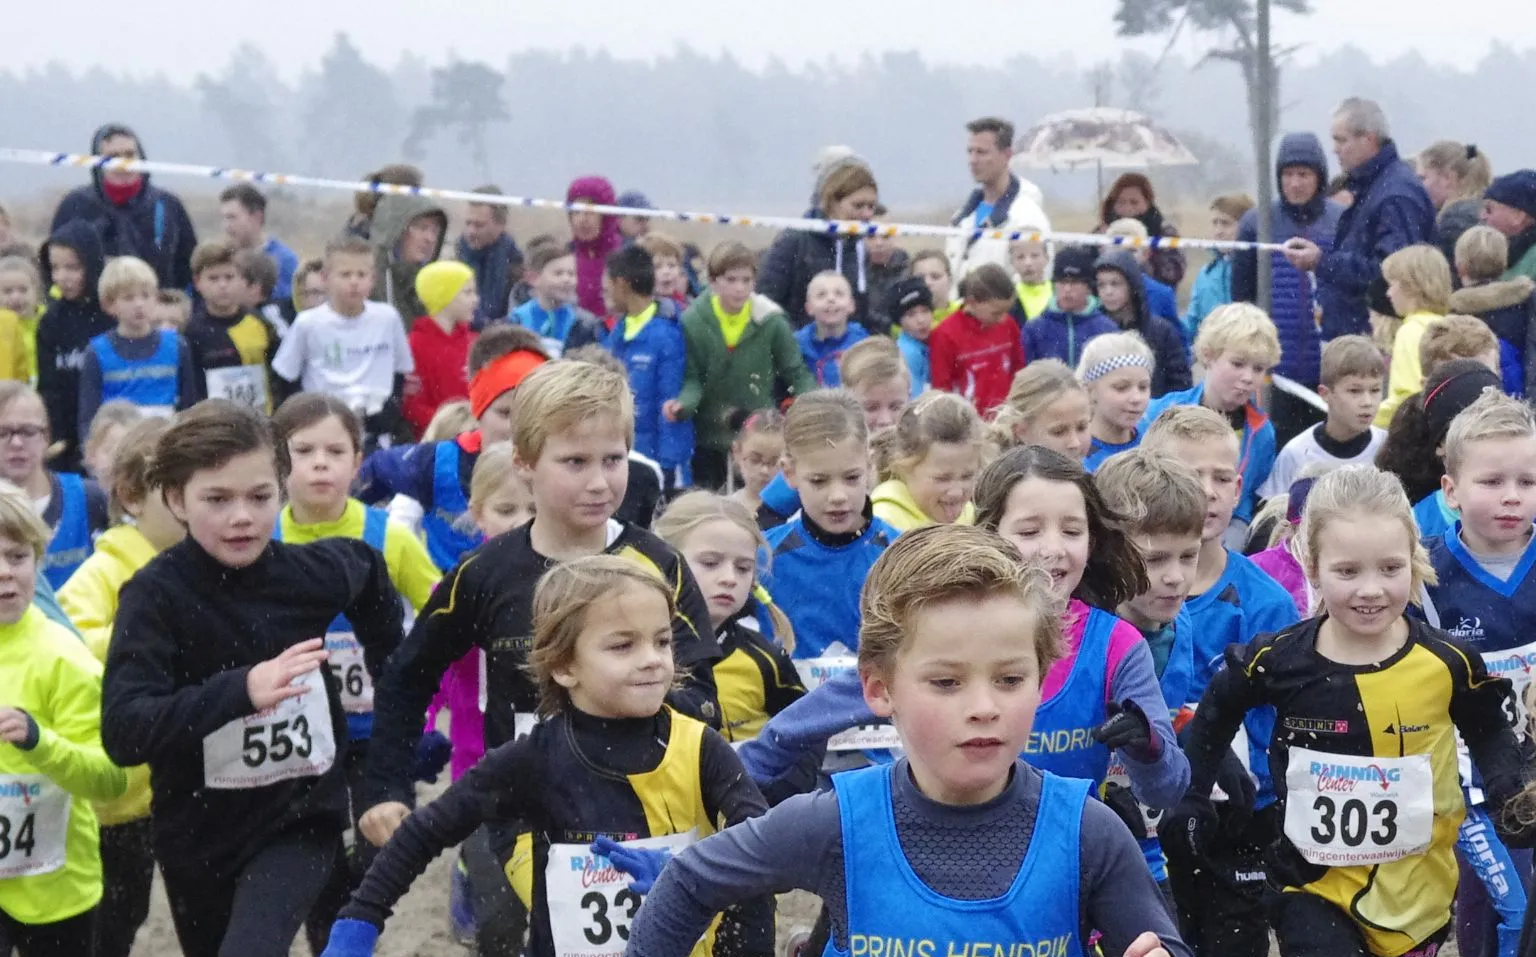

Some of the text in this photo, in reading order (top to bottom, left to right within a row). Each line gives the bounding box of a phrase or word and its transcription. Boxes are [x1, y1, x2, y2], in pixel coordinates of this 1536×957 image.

[242, 714, 312, 768] 553
[1025, 728, 1093, 754] ENDRI
[1310, 761, 1401, 782] RUNNING
[1318, 768, 1359, 793] Center
[1311, 796, 1398, 846] 303
[0, 812, 35, 860] 34
[566, 832, 623, 842] SPRNT
[582, 861, 625, 888] Center
[1235, 870, 1266, 882] humm
[581, 887, 642, 946] 33
